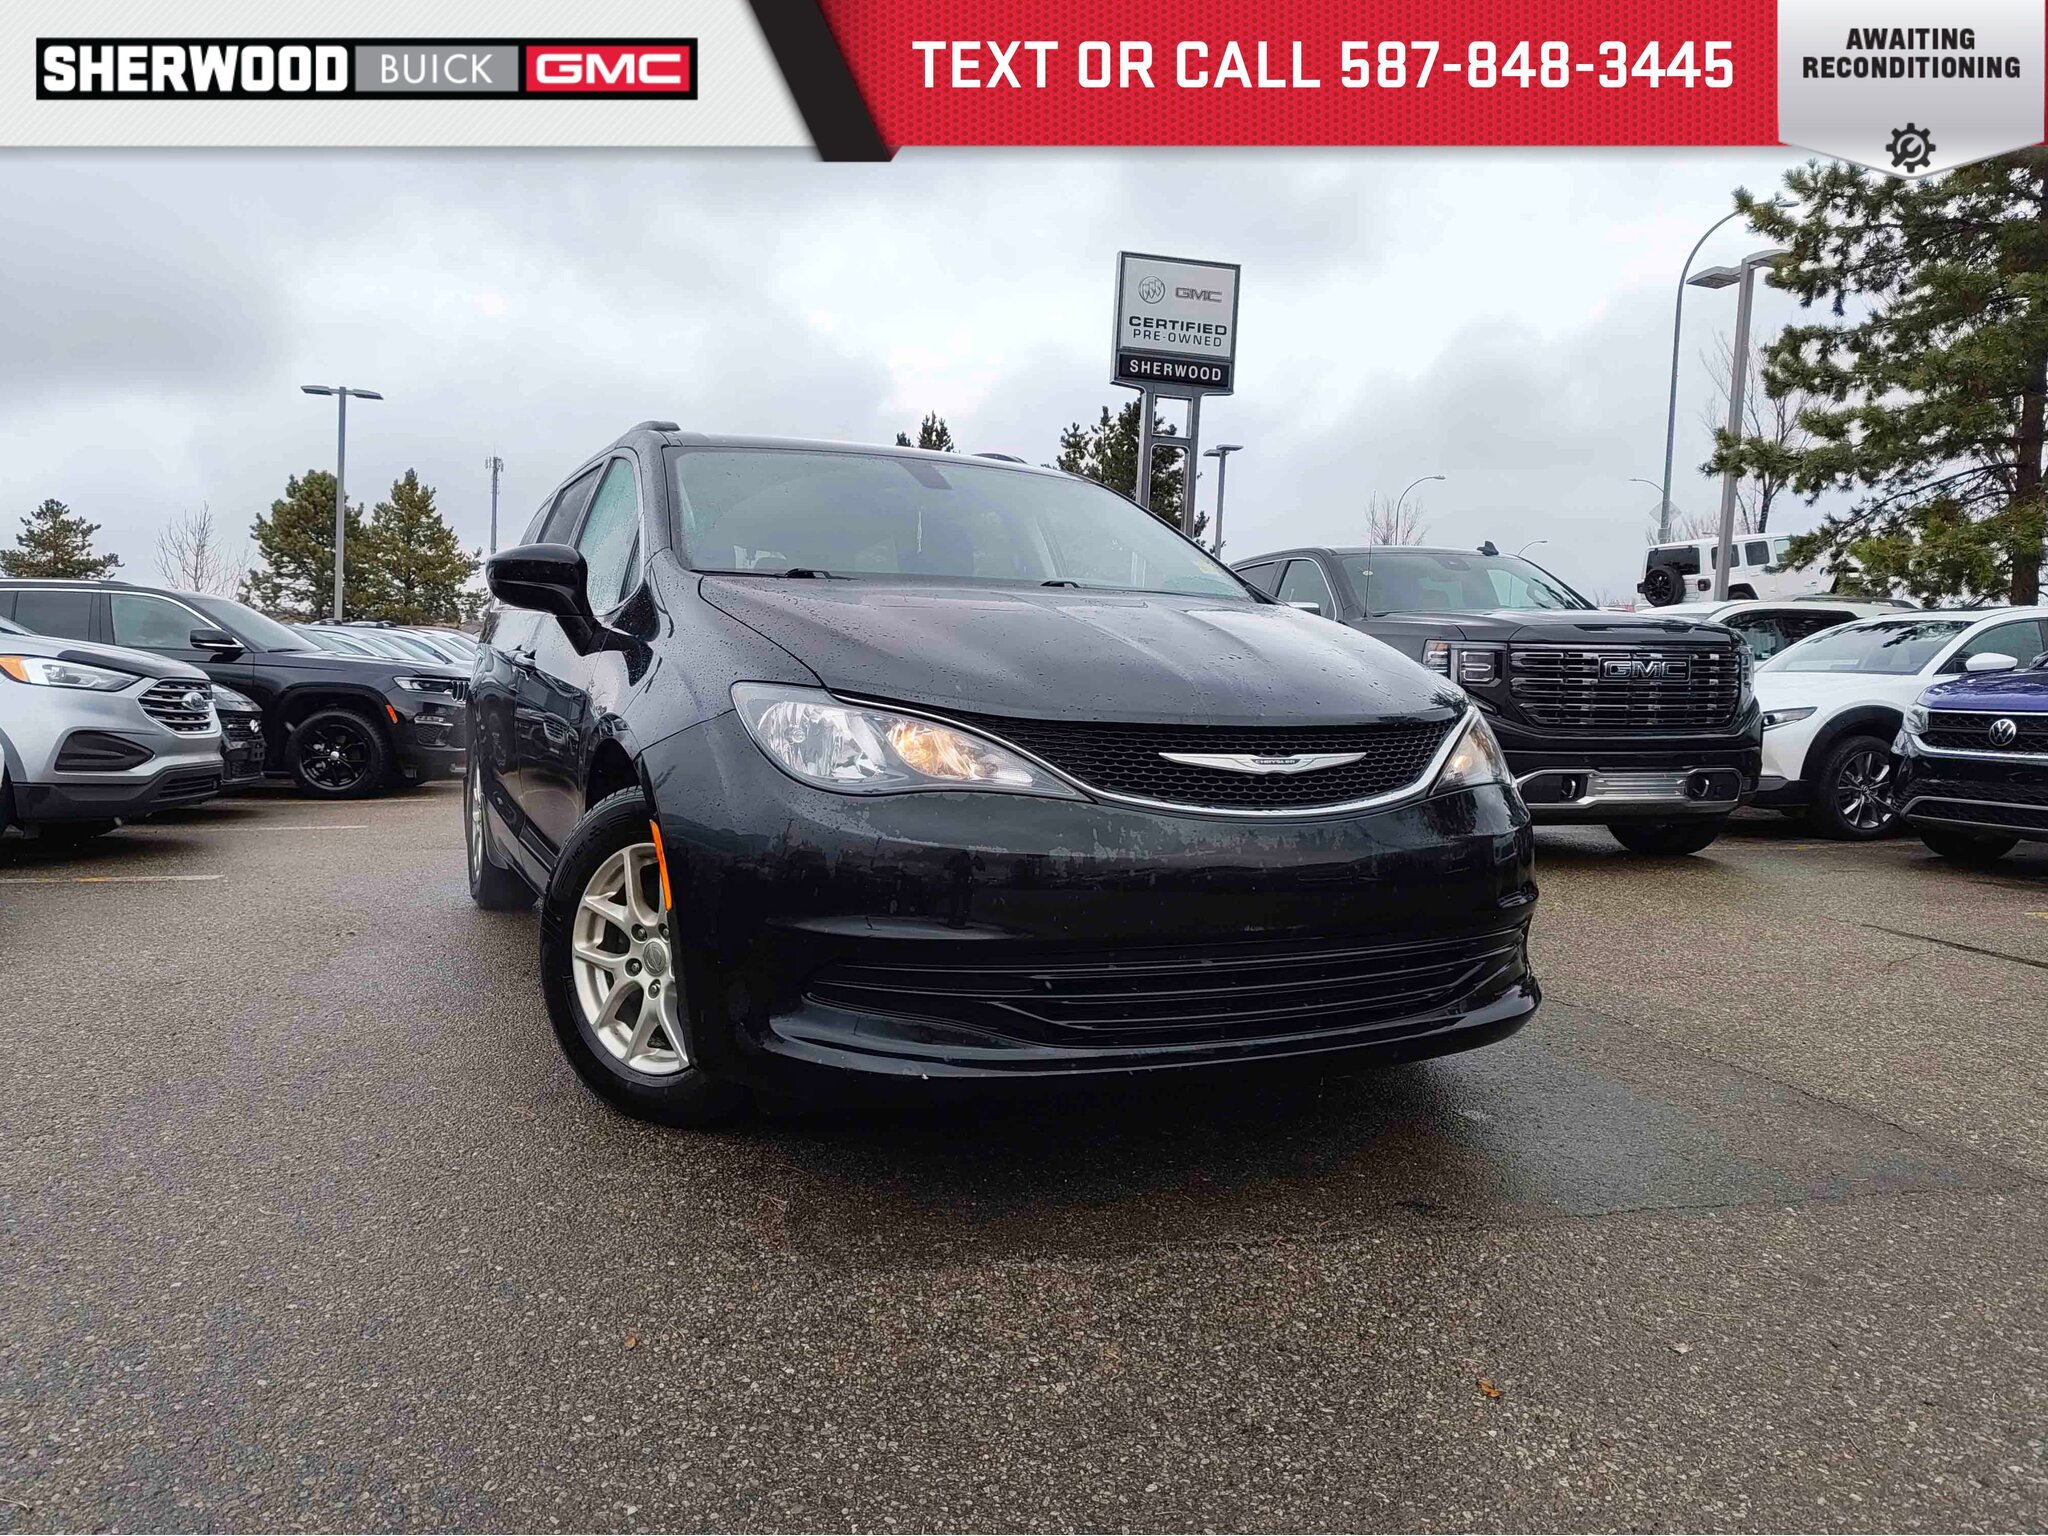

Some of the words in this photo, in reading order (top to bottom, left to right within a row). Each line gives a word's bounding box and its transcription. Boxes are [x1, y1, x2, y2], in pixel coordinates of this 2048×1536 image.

[1175, 287, 1222, 303] GMC
[1129, 316, 1227, 336] CERTIFIED
[1133, 329, 1222, 347] PRE-OWNED
[1129, 359, 1221, 381] SHERWOOD
[1603, 660, 1687, 678] GMC
